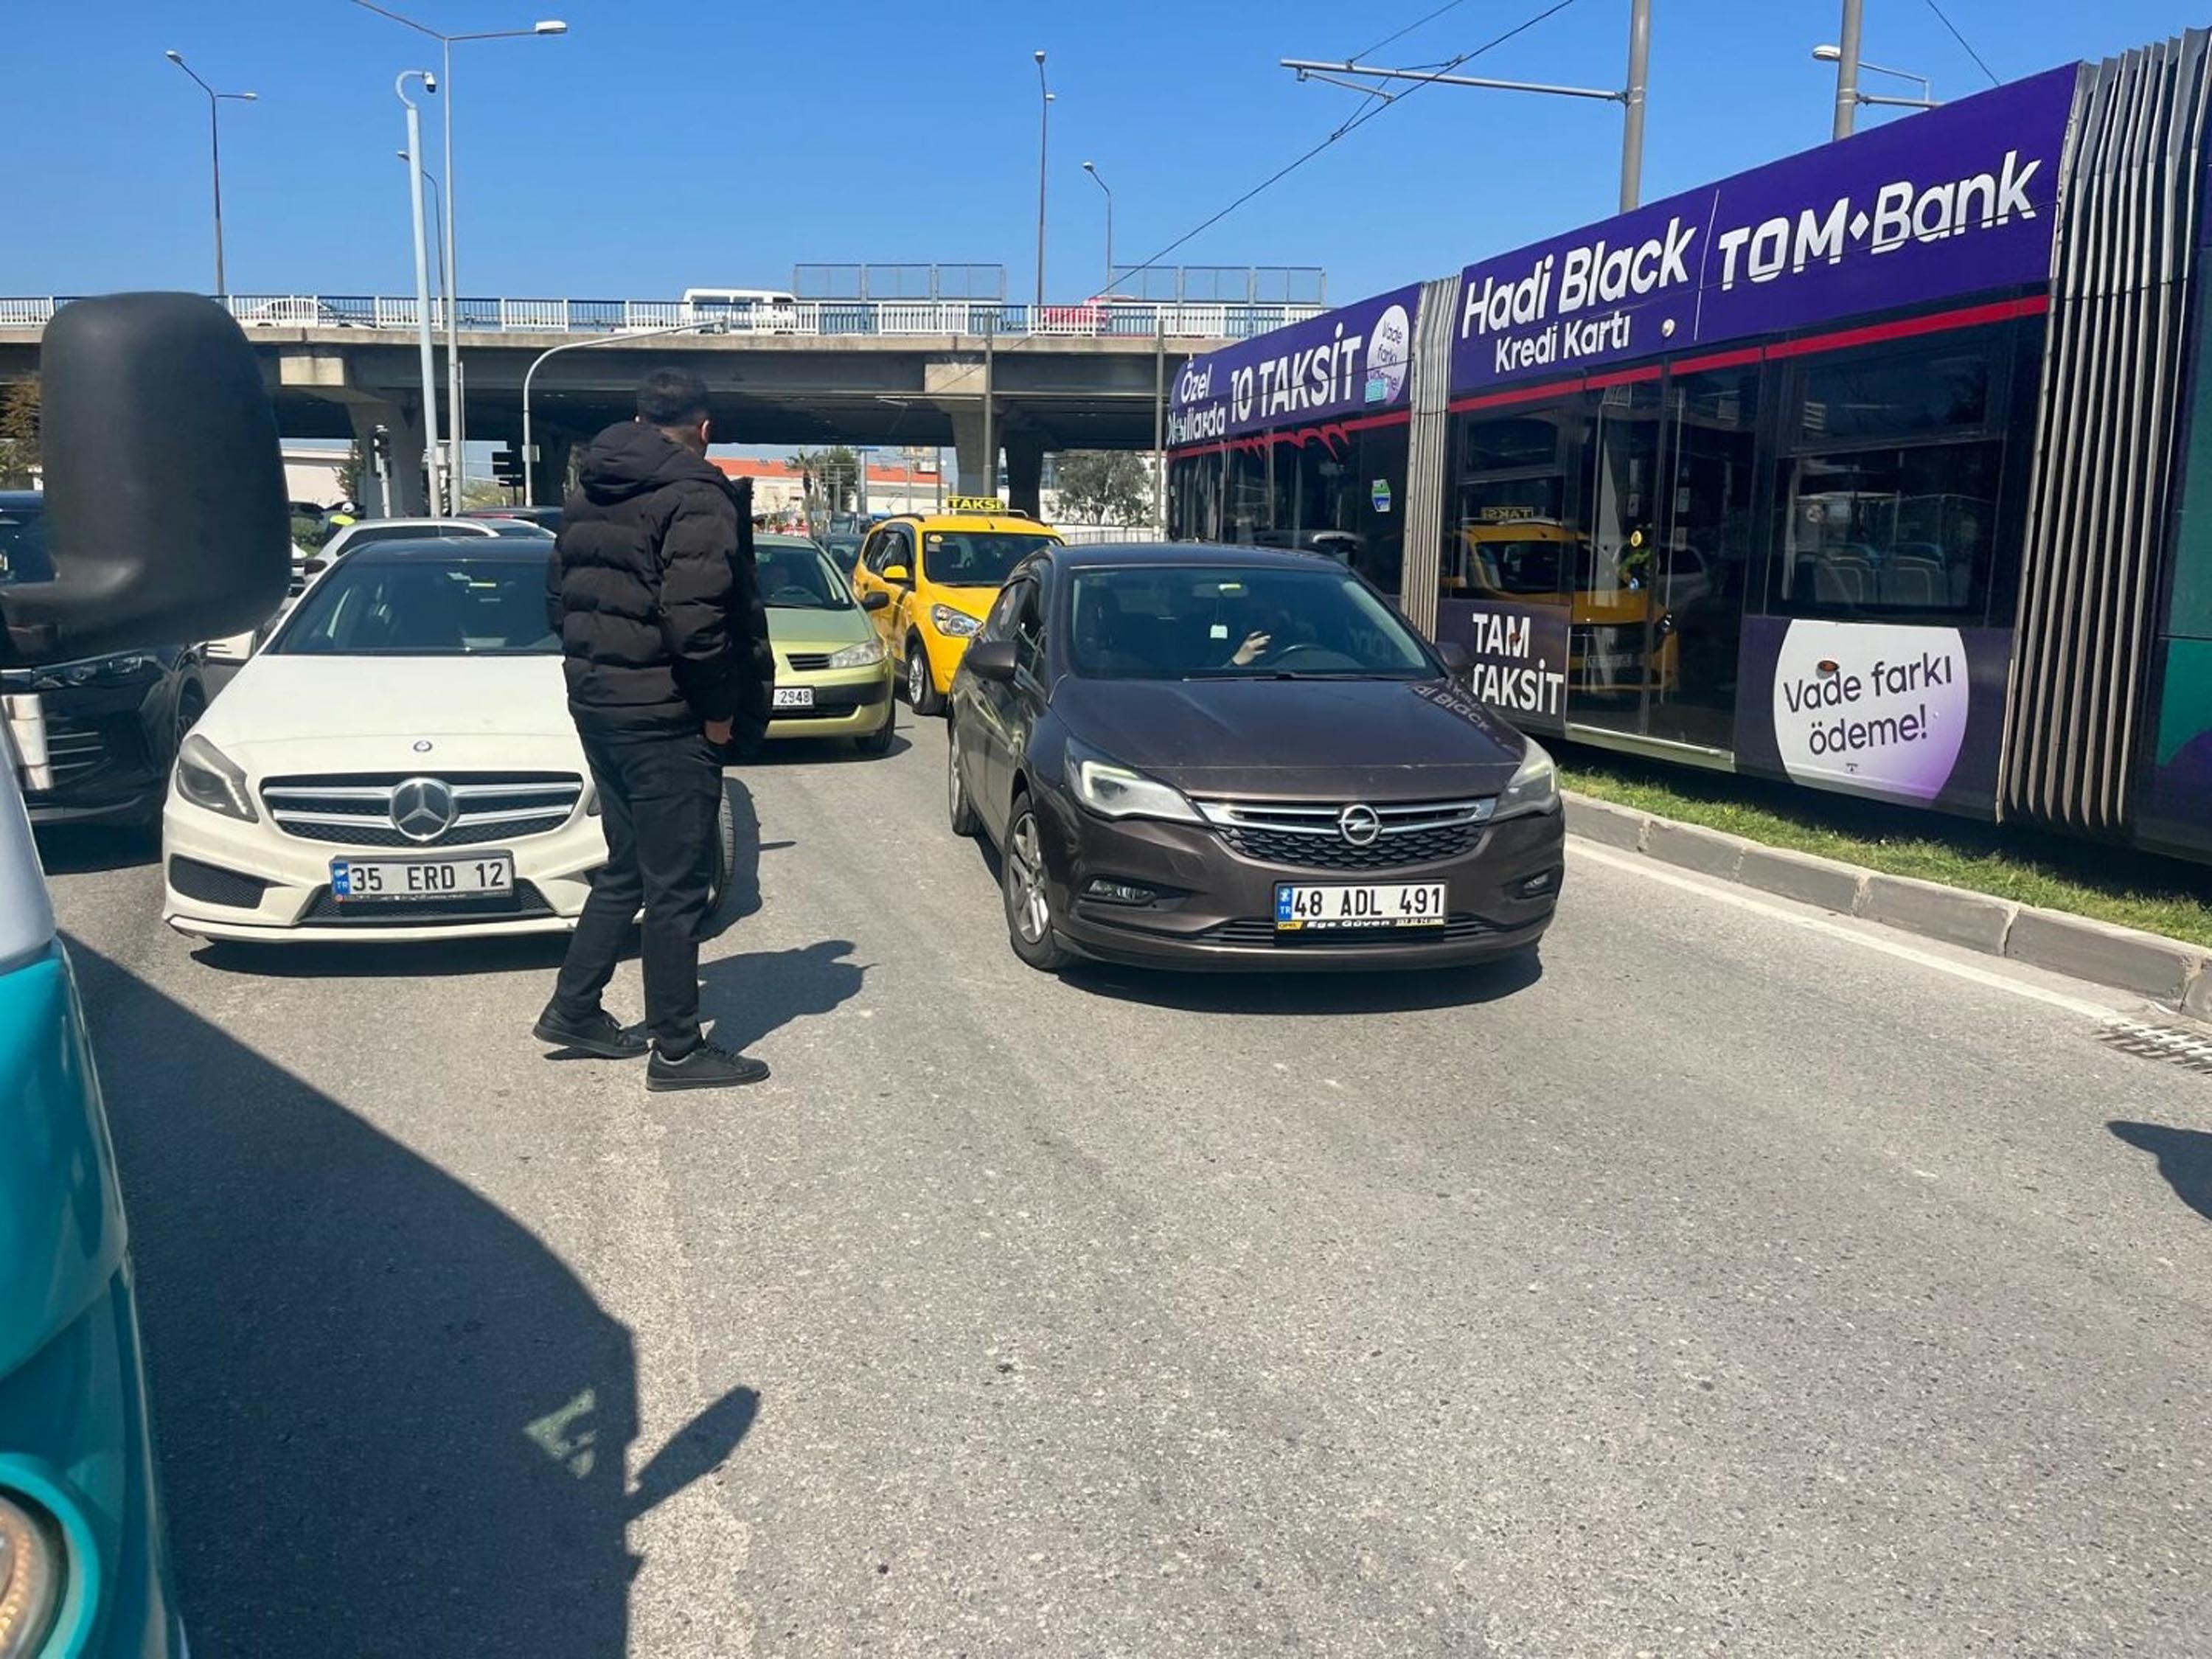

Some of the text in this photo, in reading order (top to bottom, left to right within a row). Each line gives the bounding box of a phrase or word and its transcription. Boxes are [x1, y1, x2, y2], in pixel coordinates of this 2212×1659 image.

[1462, 217, 1697, 339] Hadi Black
[1495, 310, 1631, 374] Kredi Kartı
[1181, 361, 1213, 403] Özel
[1231, 321, 1363, 423] 10 TAKSİT
[1472, 613, 1531, 658] TAM
[1472, 658, 1564, 714] TAKSİT
[1784, 672, 1861, 713] Vade
[1871, 653, 1952, 696] farkı
[779, 690, 810, 703] 2948
[1809, 704, 1928, 755] ödeme!
[352, 862, 504, 892] 35 ERD 12
[1280, 905, 1291, 915] TR
[1294, 888, 1441, 917] 48 ADL 491
